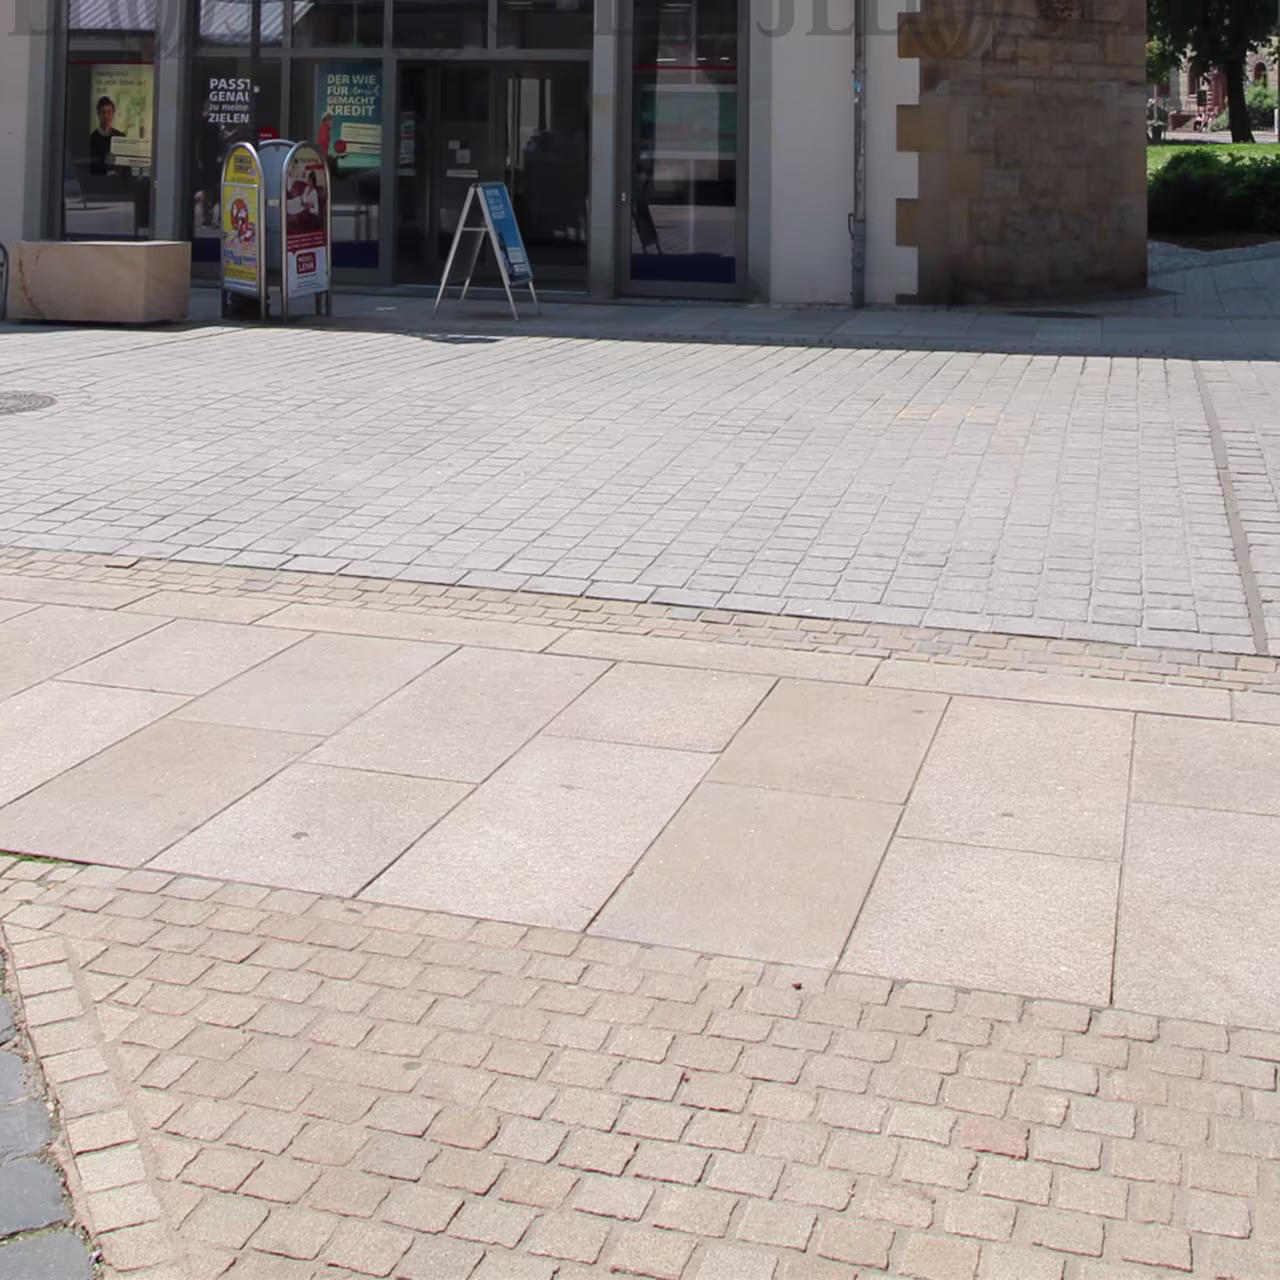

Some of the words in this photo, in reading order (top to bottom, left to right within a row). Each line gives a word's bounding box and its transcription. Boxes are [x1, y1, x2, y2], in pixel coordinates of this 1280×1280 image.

[327, 74, 350, 84] DER
[352, 74, 376, 84] WIE
[327, 85, 348, 95] FÜR
[327, 96, 375, 105] GEMACHT
[327, 105, 375, 116] KREDIT
[208, 113, 250, 124] ZIELEN
